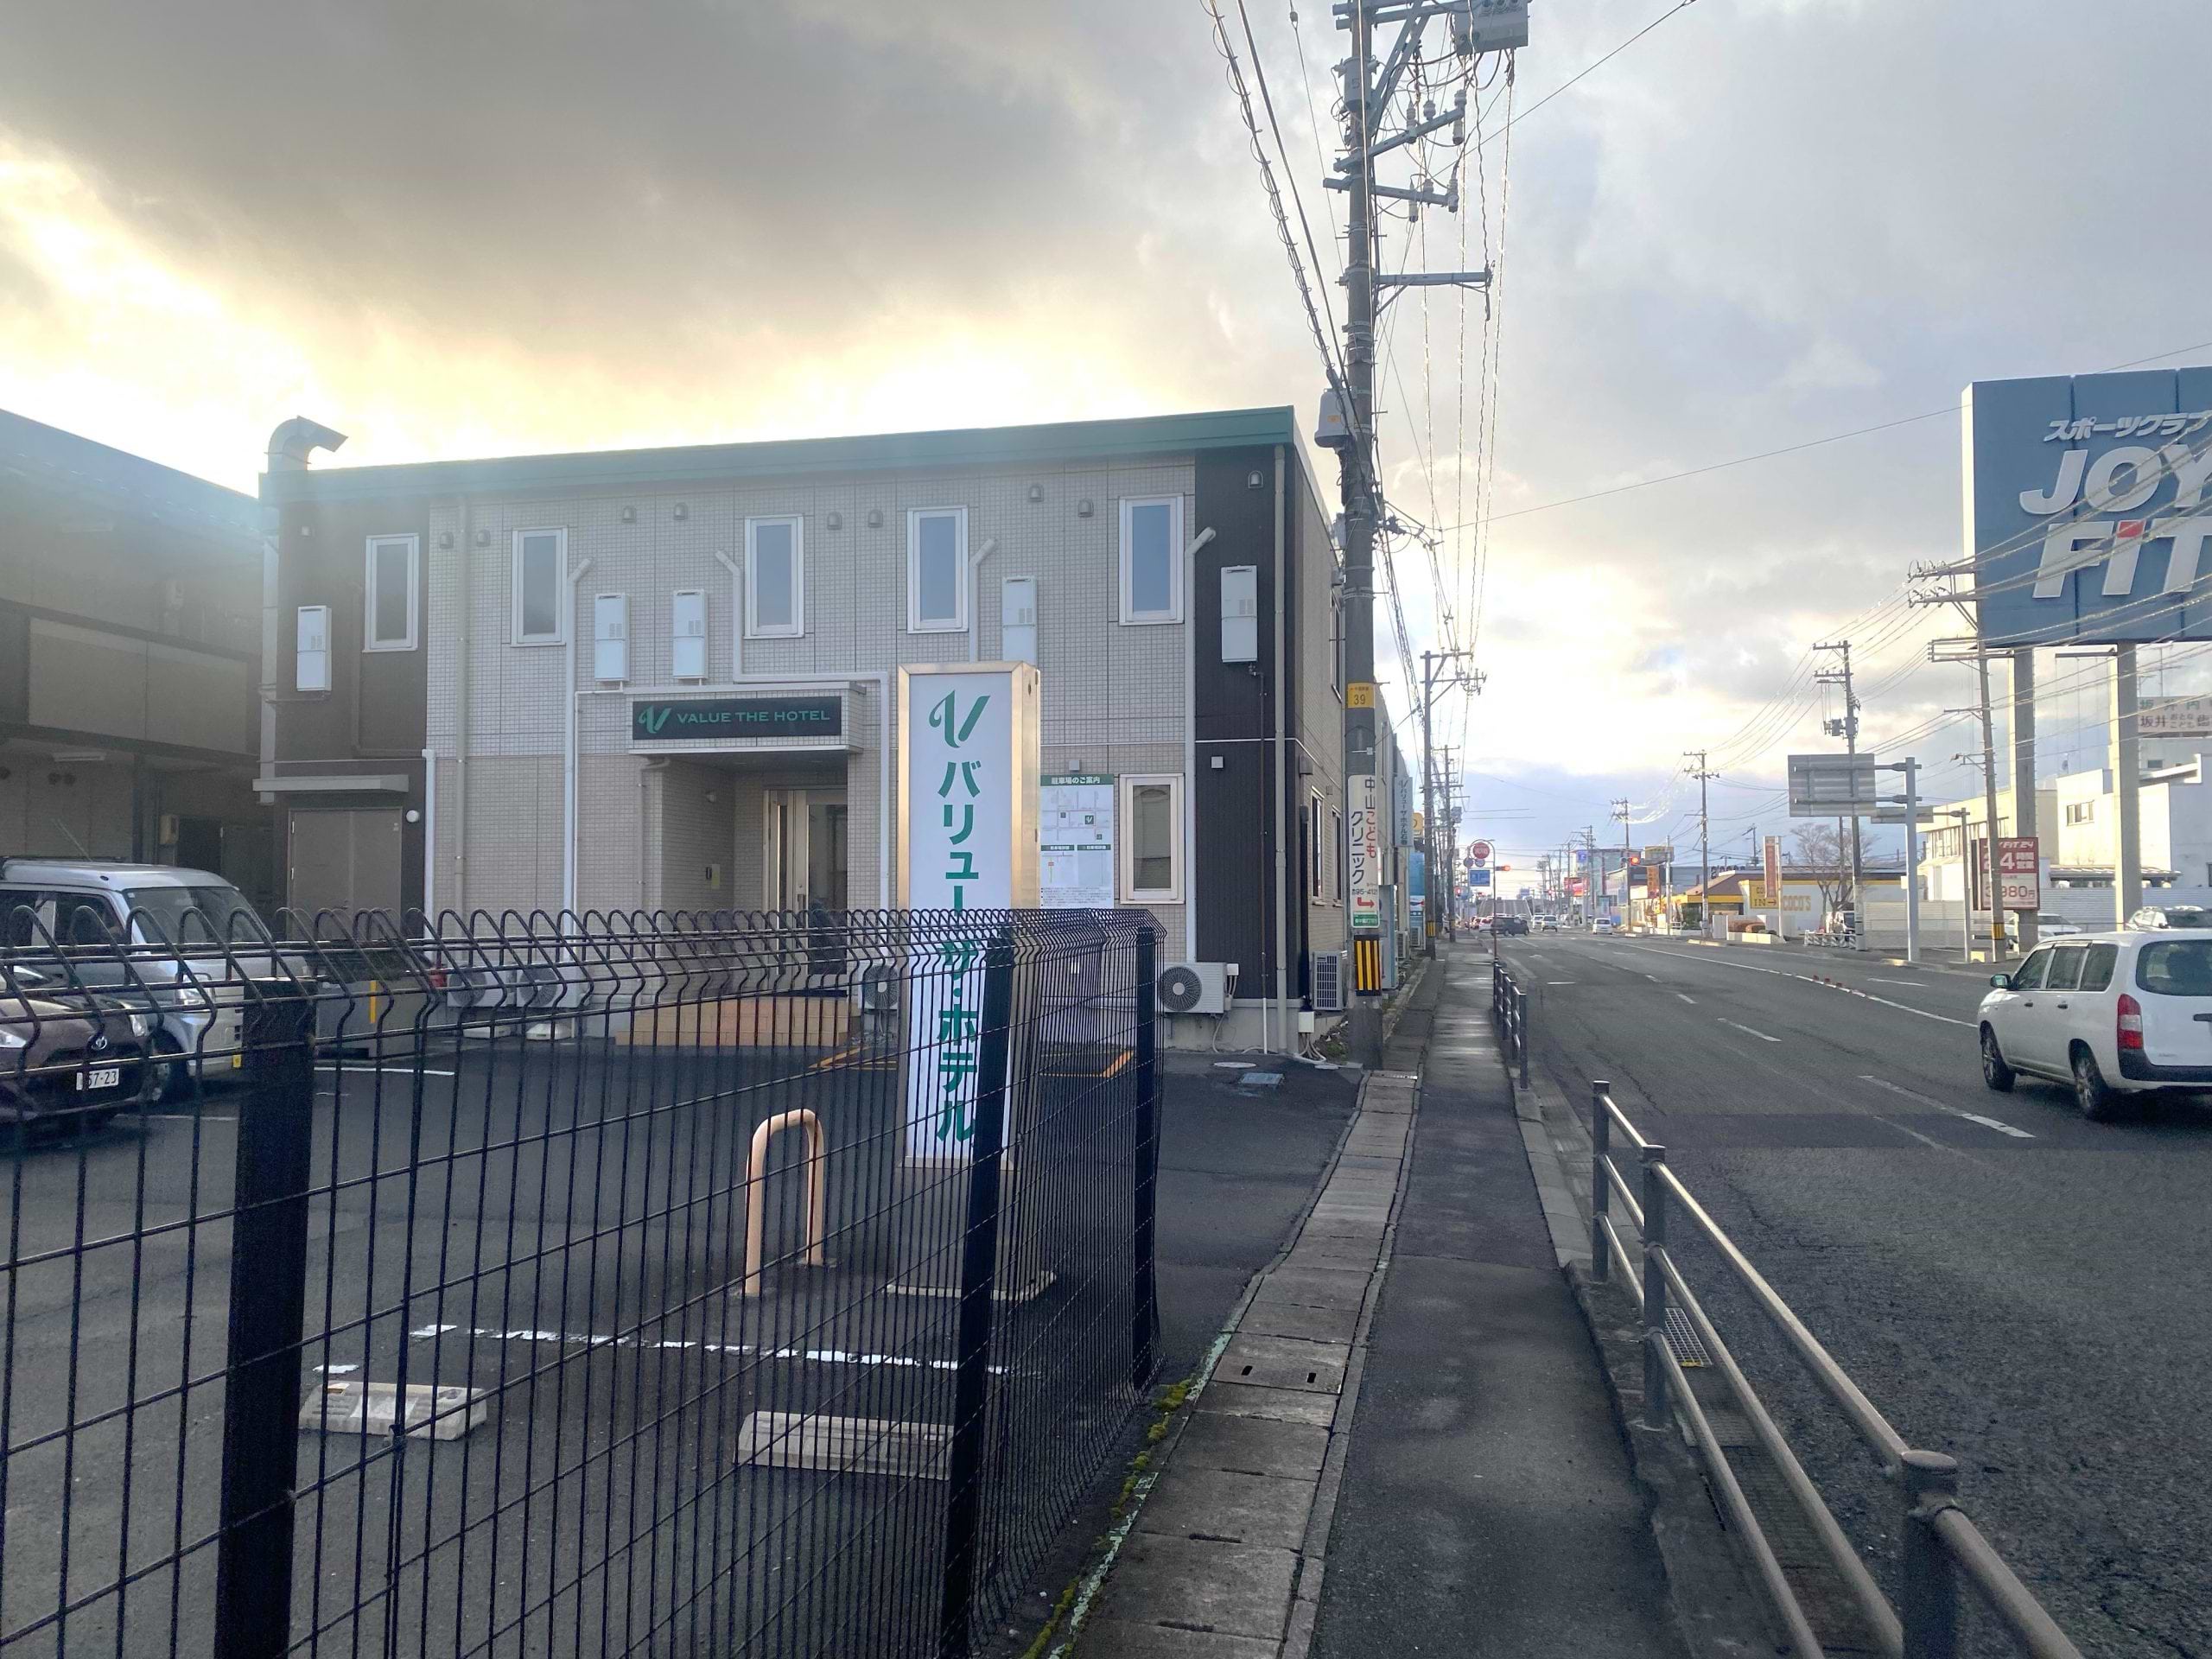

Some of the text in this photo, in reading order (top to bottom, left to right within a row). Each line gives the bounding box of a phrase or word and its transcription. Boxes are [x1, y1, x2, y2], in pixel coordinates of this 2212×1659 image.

[2018, 445, 2212, 516] JOY
[677, 712, 732, 724] VALUE
[734, 711, 769, 722] THE
[773, 709, 830, 721] HOTEL
[1354, 694, 1366, 705] 39
[1364, 776, 1376, 859] 中山こども
[1351, 810, 1365, 885] クリニック
[1783, 895, 1811, 912] COCO'S
